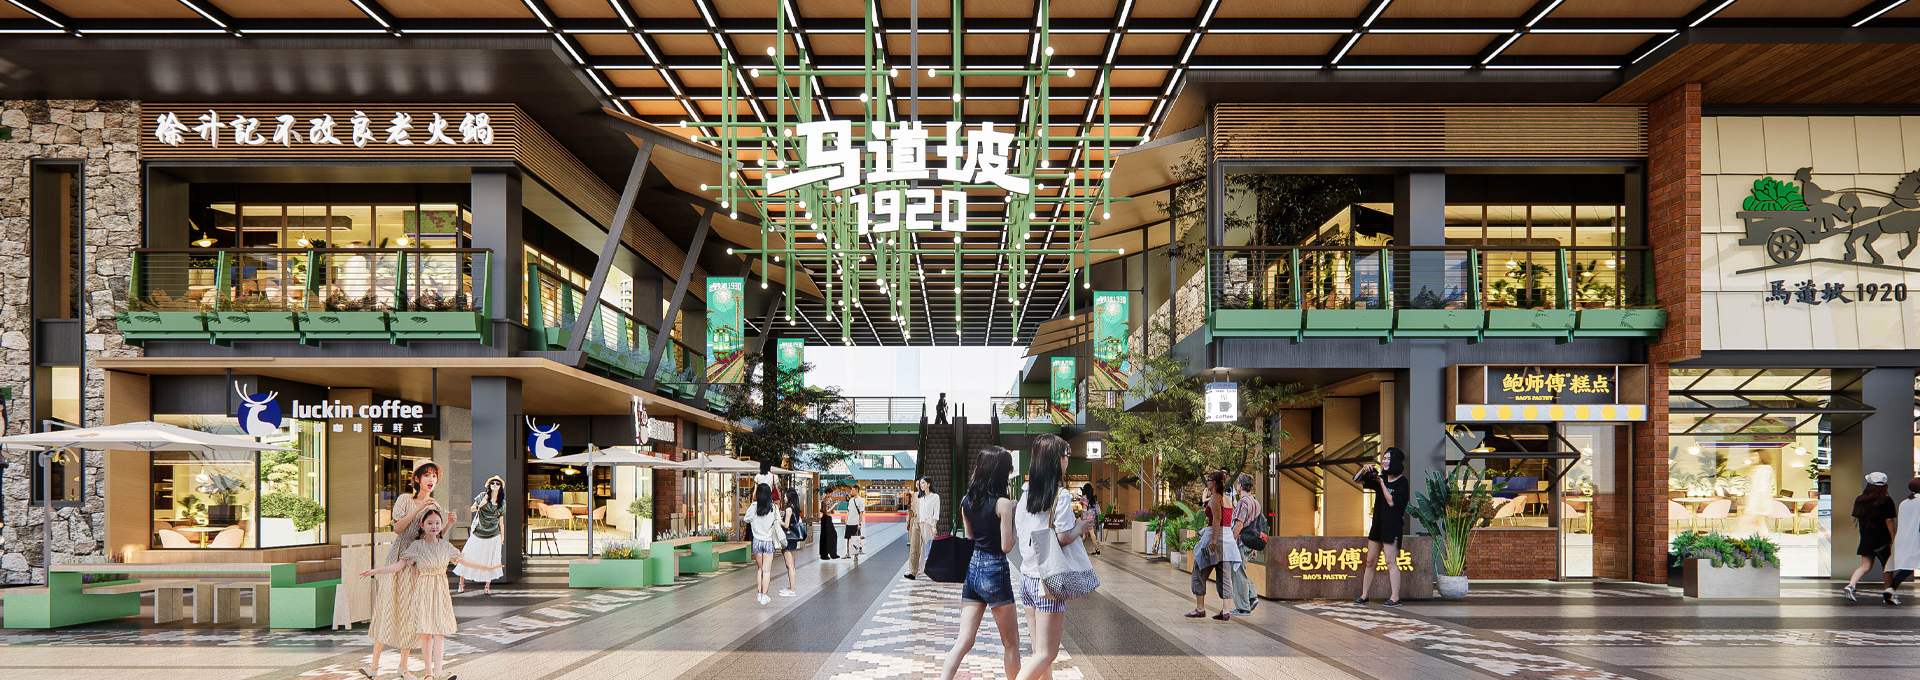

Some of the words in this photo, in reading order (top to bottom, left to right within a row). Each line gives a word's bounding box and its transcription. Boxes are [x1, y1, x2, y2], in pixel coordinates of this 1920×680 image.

[154, 109, 494, 148] 徐升記不改良老火鍋
[767, 120, 1030, 195] 马道坡
[850, 189, 967, 235] 1920
[292, 400, 354, 418] luckin
[358, 400, 424, 418] coffee
